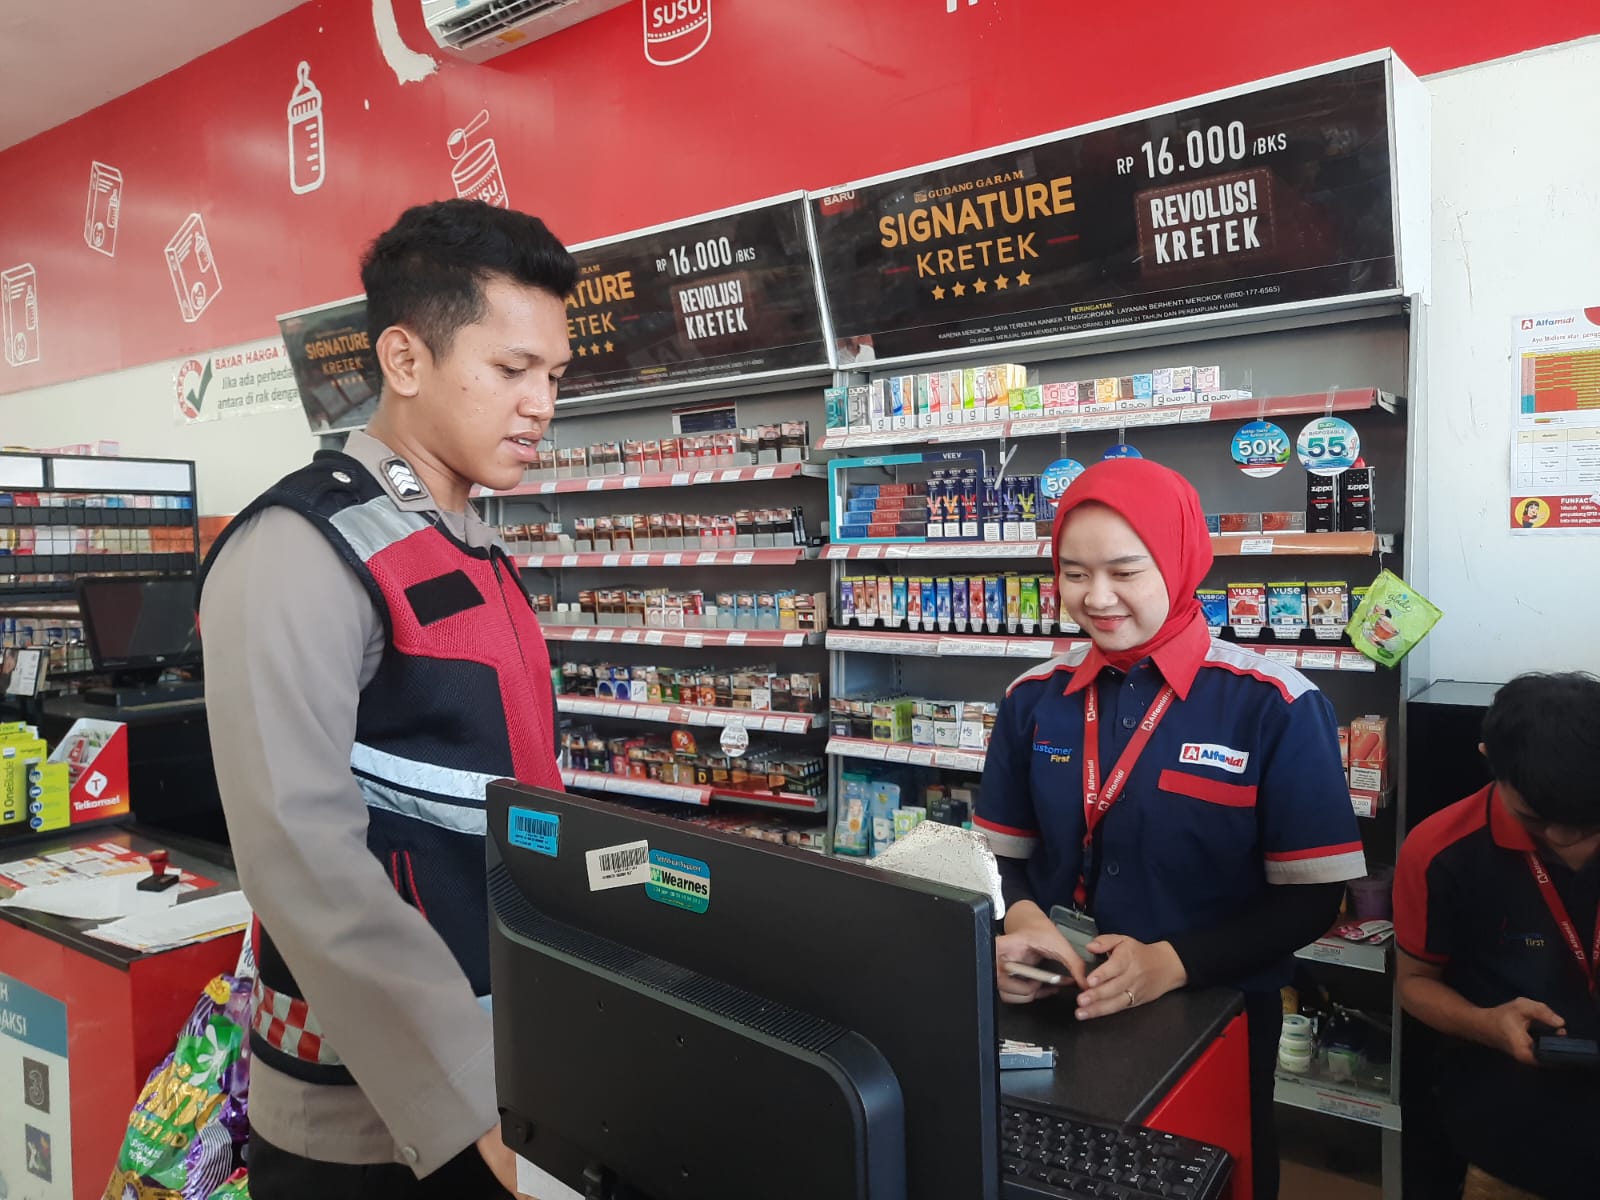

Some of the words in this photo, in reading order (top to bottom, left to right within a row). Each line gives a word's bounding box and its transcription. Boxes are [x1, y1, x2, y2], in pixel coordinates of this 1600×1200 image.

[653, 0, 701, 28] SUSU
[1117, 156, 1134, 175] RP
[1142, 121, 1246, 178] 16.000
[1252, 133, 1287, 156] /BKS
[824, 190, 855, 206] BARU
[928, 181, 973, 199] GUDANG
[976, 170, 1024, 188] GARAM
[879, 176, 1076, 248] SIGNATURE
[1154, 216, 1260, 264] KRETEK
[656, 259, 667, 273] RP
[669, 236, 733, 276] 16.000
[735, 247, 756, 264] /BKS
[917, 232, 1040, 278] KRETEK
[565, 270, 636, 309] ATURE
[1149, 299, 1184, 310] BERHENTI
[1185, 293, 1222, 305] MEROKOK
[567, 311, 617, 339] ETEK
[684, 307, 749, 341] KRETEK
[1536, 317, 1575, 326] Alfamidi
[215, 354, 243, 370] BAYAR
[246, 346, 279, 364] HARGA
[305, 331, 371, 360] SIGNATURE
[239, 371, 255, 387] ada
[257, 364, 294, 387] perbeda
[321, 355, 364, 376] KRETEK
[256, 389, 270, 403] rak
[271, 387, 299, 402] denga
[1239, 438, 1282, 456] 50K
[1047, 476, 1075, 491] 50
[1033, 743, 1072, 755] ustomer
[1050, 754, 1070, 763] First
[1087, 759, 1096, 790] Alfamidi
[1105, 769, 1125, 800] Alfamidi
[73, 795, 121, 811] Telkomsel
[662, 870, 708, 895] Wearnes
[1, 1009, 27, 1037] AKSI
